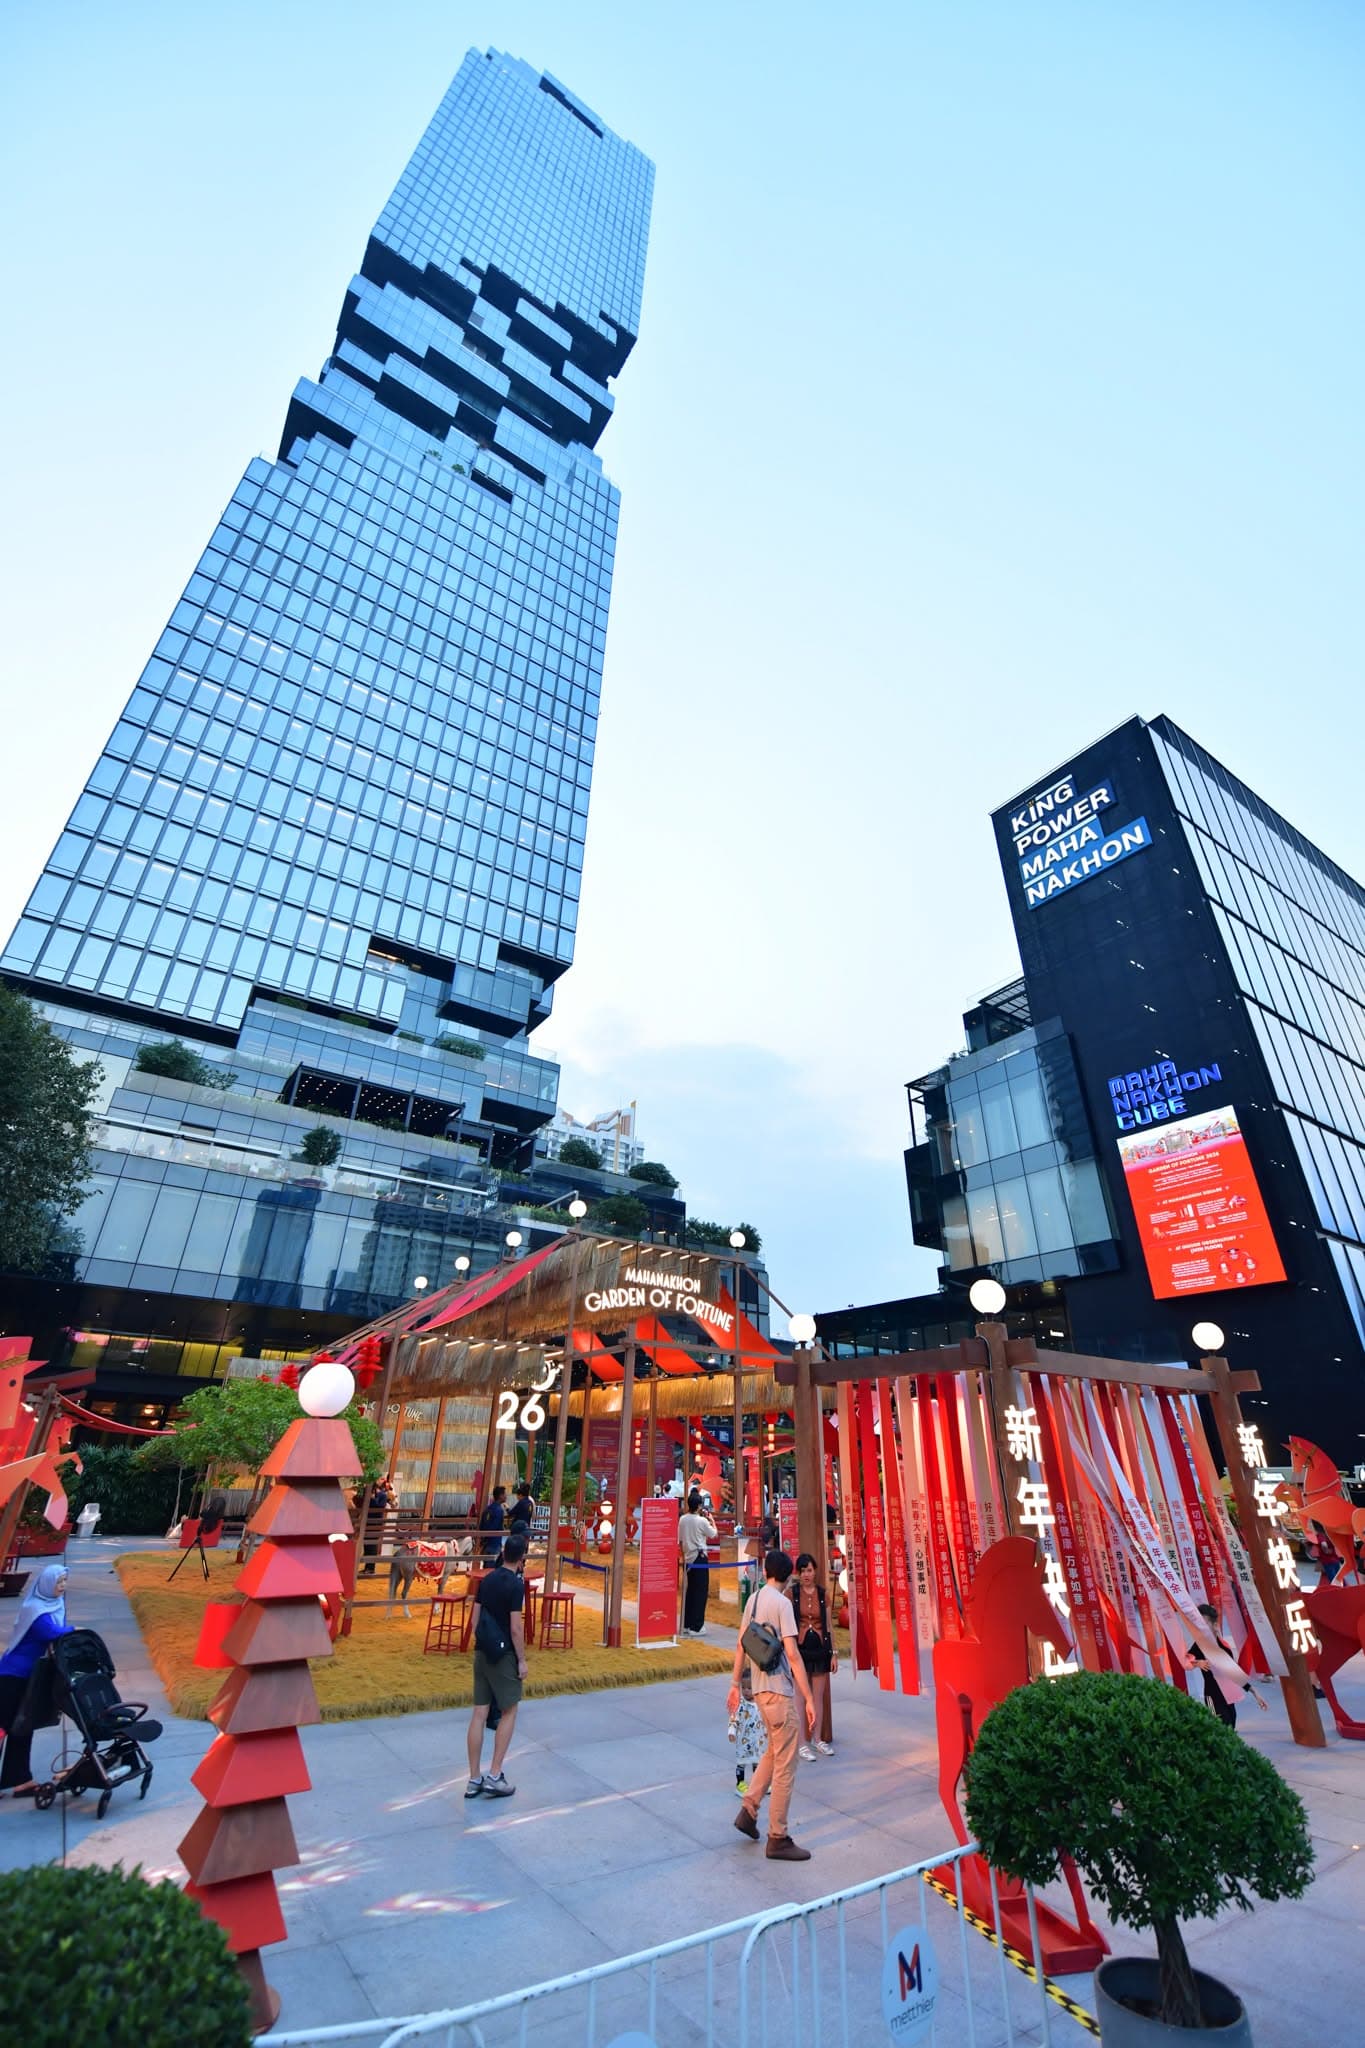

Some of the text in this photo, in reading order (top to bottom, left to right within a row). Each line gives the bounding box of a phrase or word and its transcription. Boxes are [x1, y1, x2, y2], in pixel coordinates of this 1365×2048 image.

[1011, 783, 1074, 833] KING
[1016, 788, 1111, 856] POWER
[1021, 826, 1099, 880] MAHA
[1026, 825, 1145, 905] NAKHON
[1108, 1060, 1178, 1098] MAHA
[1112, 1063, 1223, 1114] NAKHON
[1116, 1095, 1188, 1130] CUBE
[625, 1267, 701, 1294] MAHANAKHON
[585, 1287, 734, 1333] GARDEN OF FORTUNE
[496, 1391, 546, 1431] 26
[911, 1500, 922, 1544] 新春大吉
[1236, 1423, 1317, 1655] 新年快乐
[873, 1543, 886, 1588] 事业顺利
[894, 1545, 906, 1590] 心想事成
[1055, 1502, 1073, 1549] 身体健康
[1065, 1555, 1084, 1606] 万事如意
[1189, 1503, 1218, 1588] 一切顺心 喜气洋洋
[1230, 1541, 1250, 1582] 心想事成
[915, 1549, 927, 1594] 心想事成
[1081, 1552, 1098, 1601] 心想事成
[1116, 1550, 1130, 1595] 恭喜发财
[1152, 1547, 1181, 1594] 年年有余
[1183, 1546, 1201, 1591] 前程似锦
